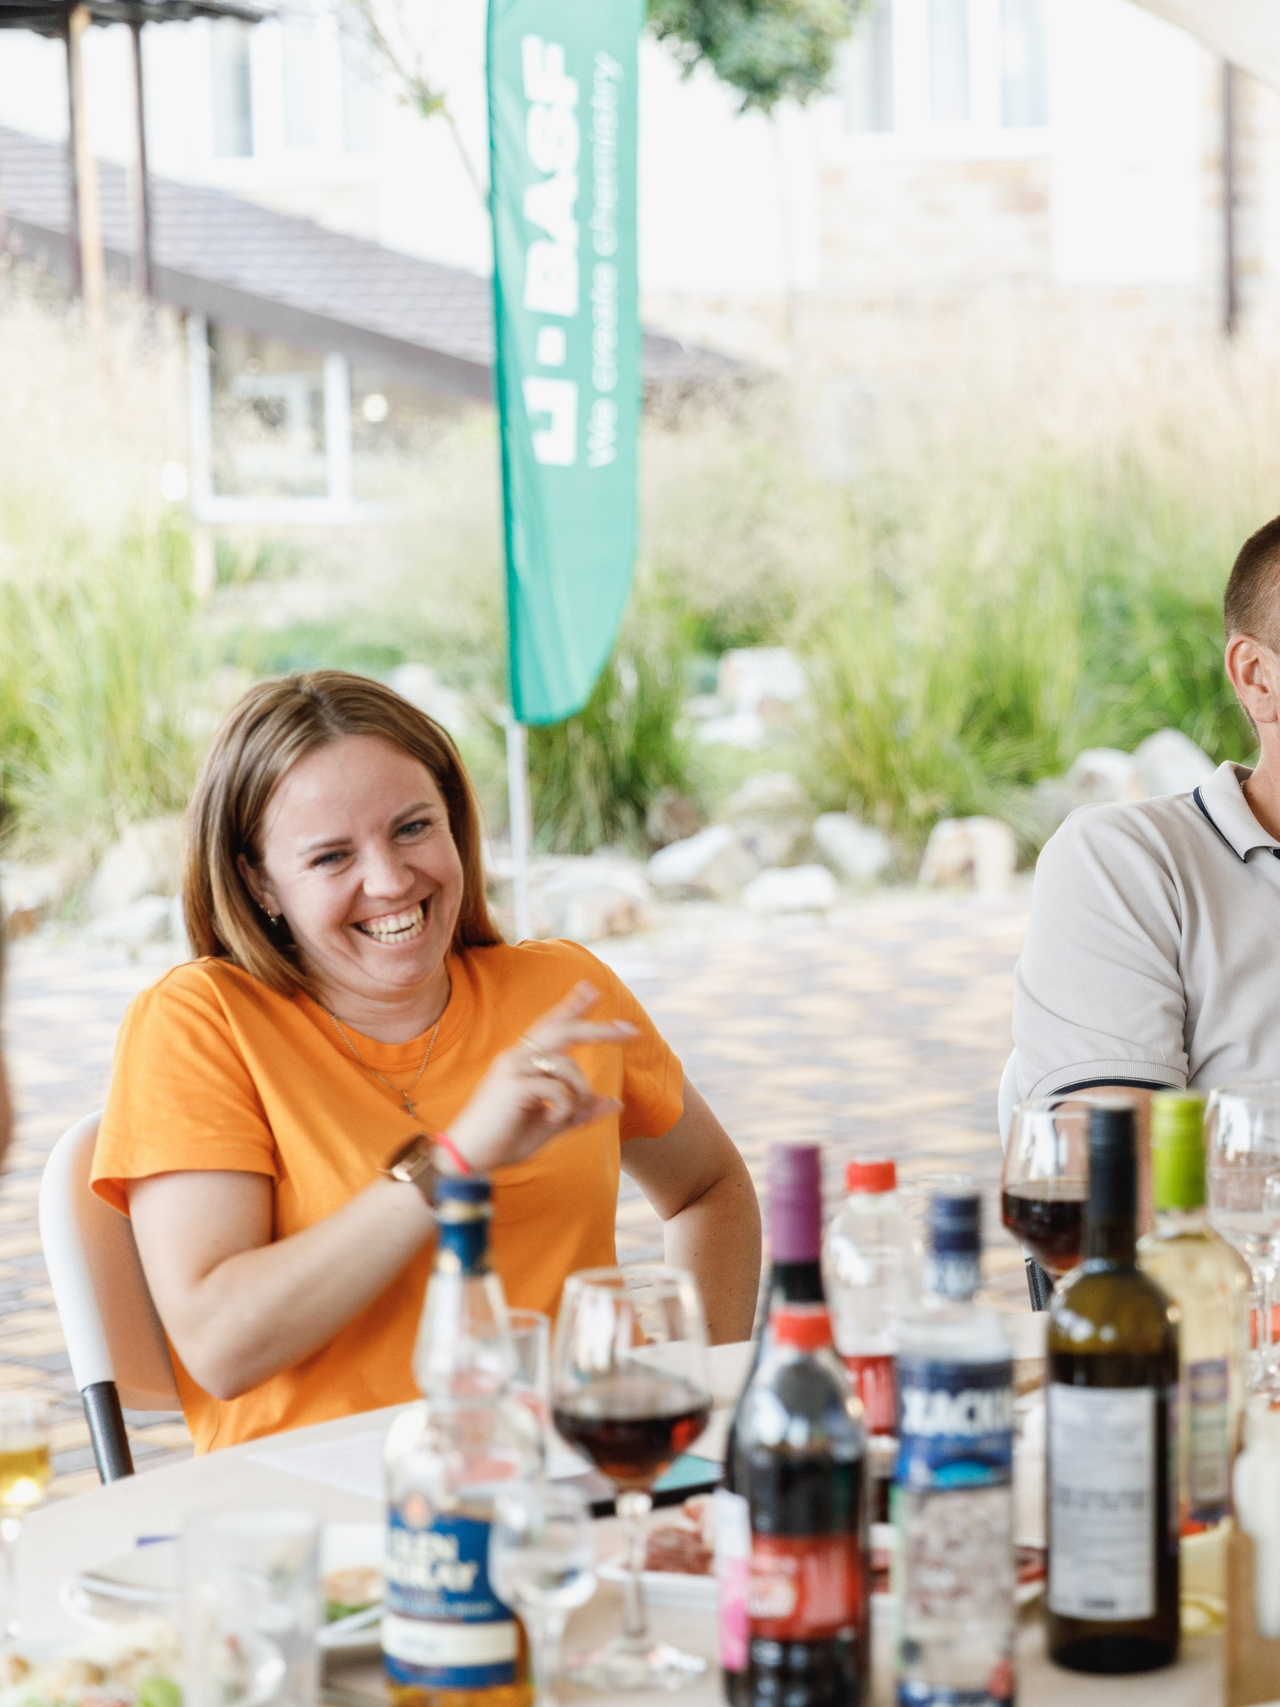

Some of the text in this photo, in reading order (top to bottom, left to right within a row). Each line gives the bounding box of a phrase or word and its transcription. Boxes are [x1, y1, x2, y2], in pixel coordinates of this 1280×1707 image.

[521, 33, 580, 317] BASF
[586, 49, 625, 468] We create chemistry
